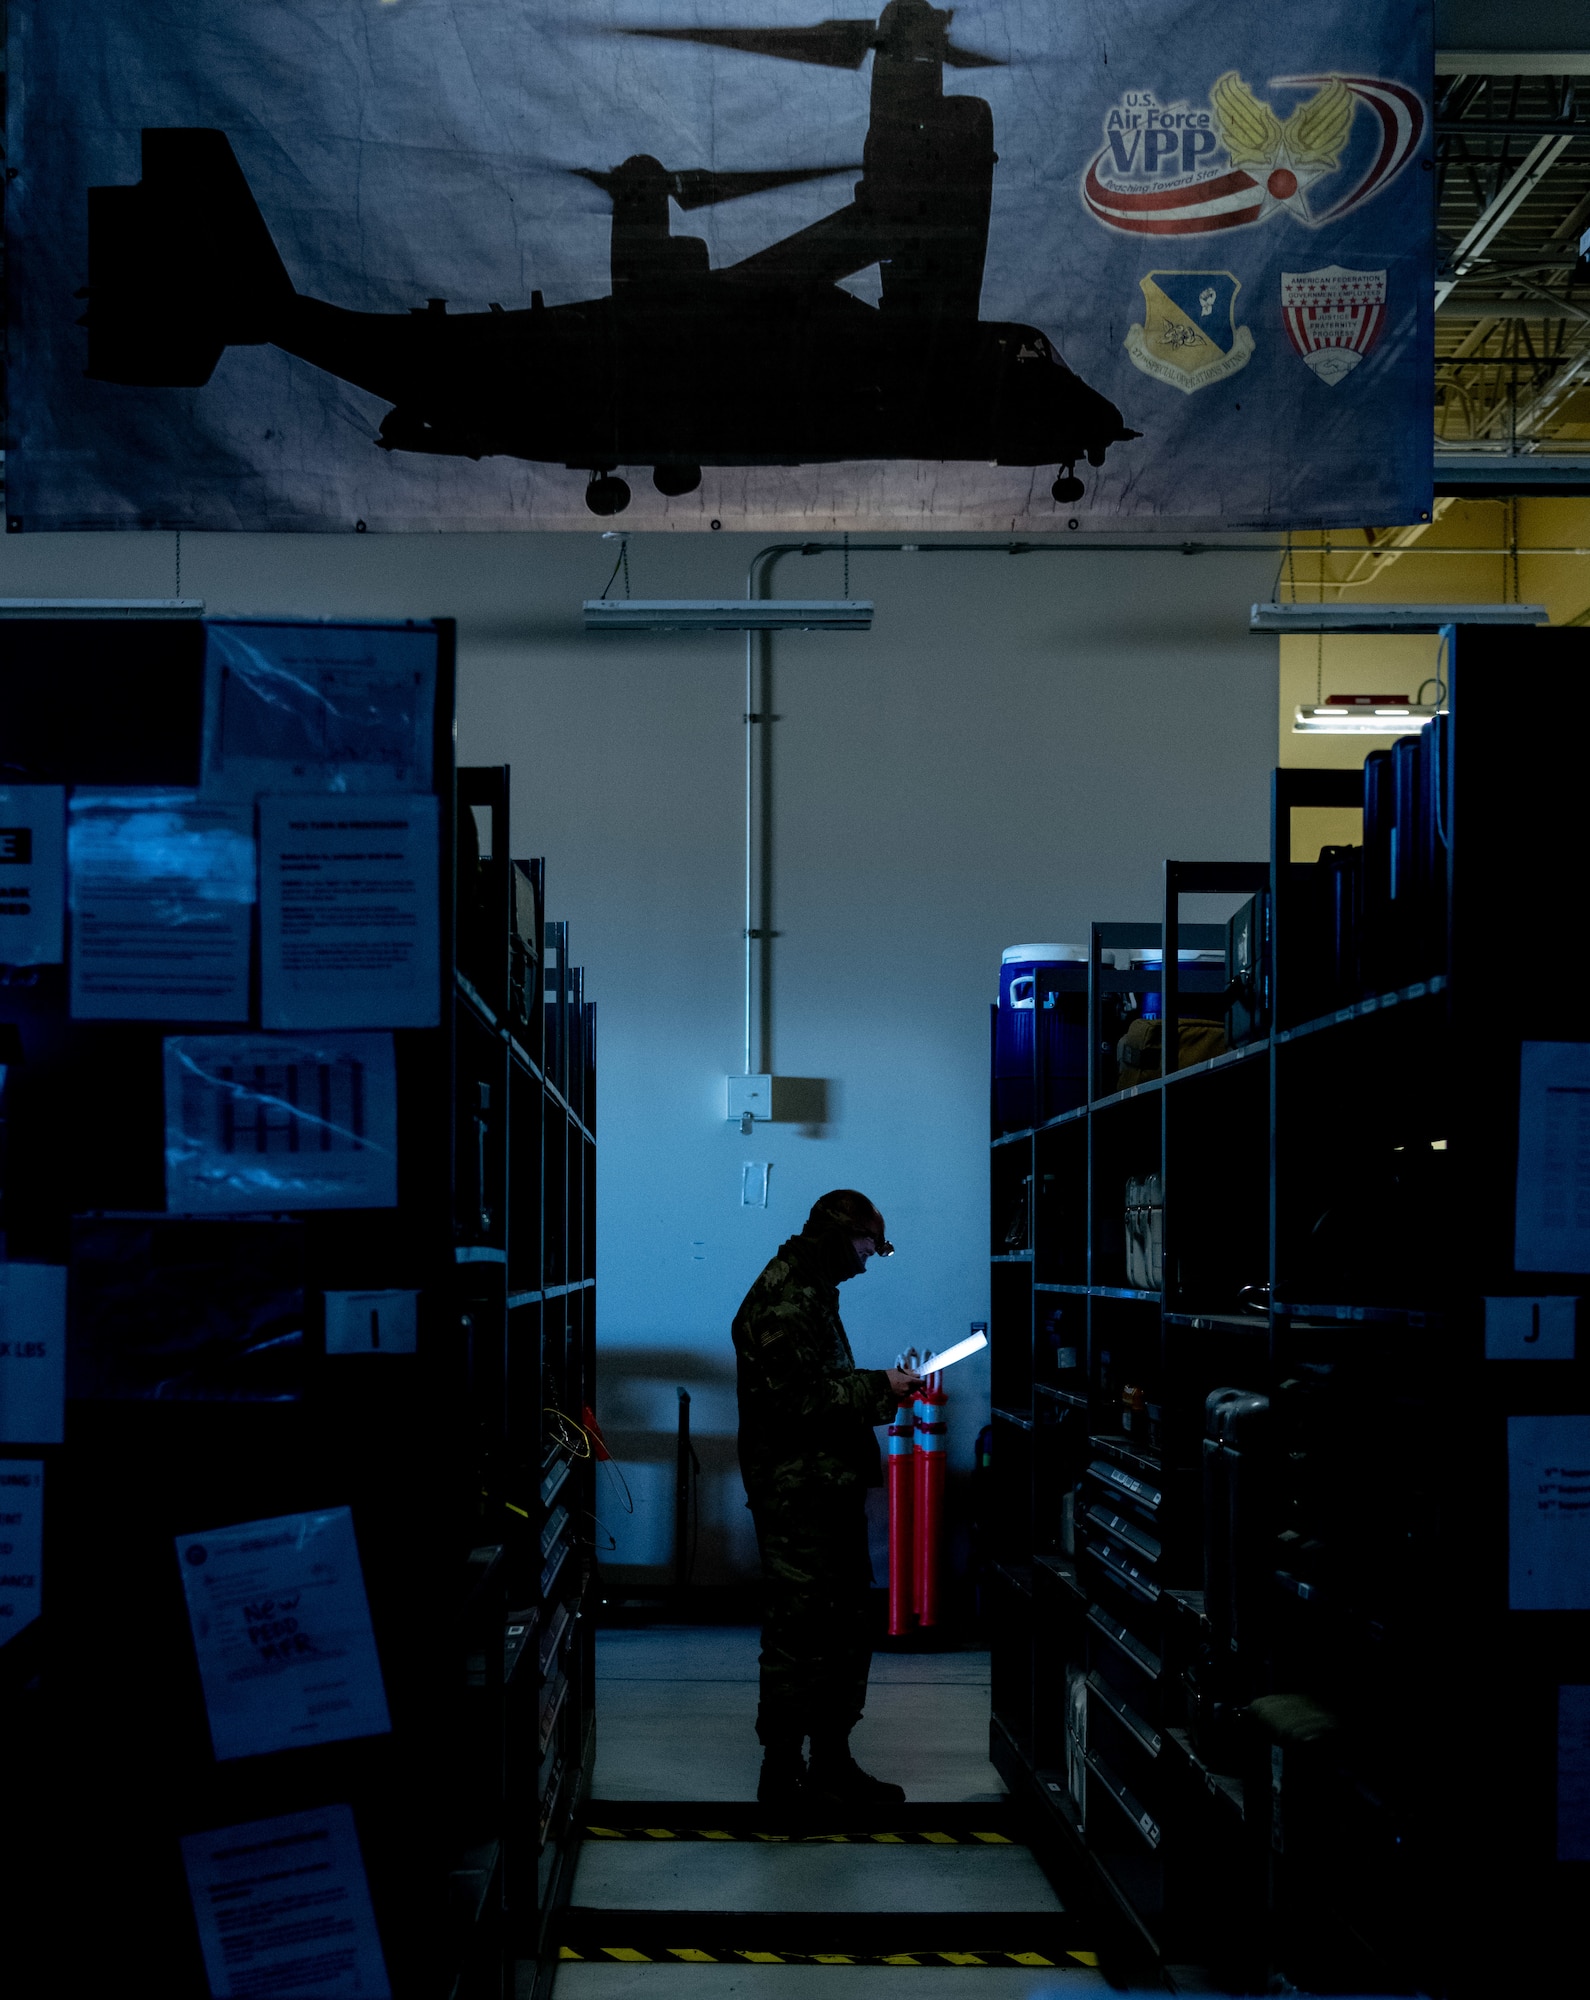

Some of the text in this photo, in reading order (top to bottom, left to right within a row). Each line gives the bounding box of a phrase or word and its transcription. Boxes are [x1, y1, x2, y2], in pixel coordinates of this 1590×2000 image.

[1126, 93, 1156, 107] U.S.
[1107, 108, 1210, 130] Air Force
[1107, 129, 1217, 173] VPP
[1105, 168, 1219, 193] Reaching Toward Star
[1332, 275, 1380, 283] FEDERATION
[1310, 321, 1358, 329] FRATERNITY
[1148, 359, 1176, 379] SPECIAL
[1523, 1303, 1540, 1343] J
[14, 1341, 46, 1359] LBS
